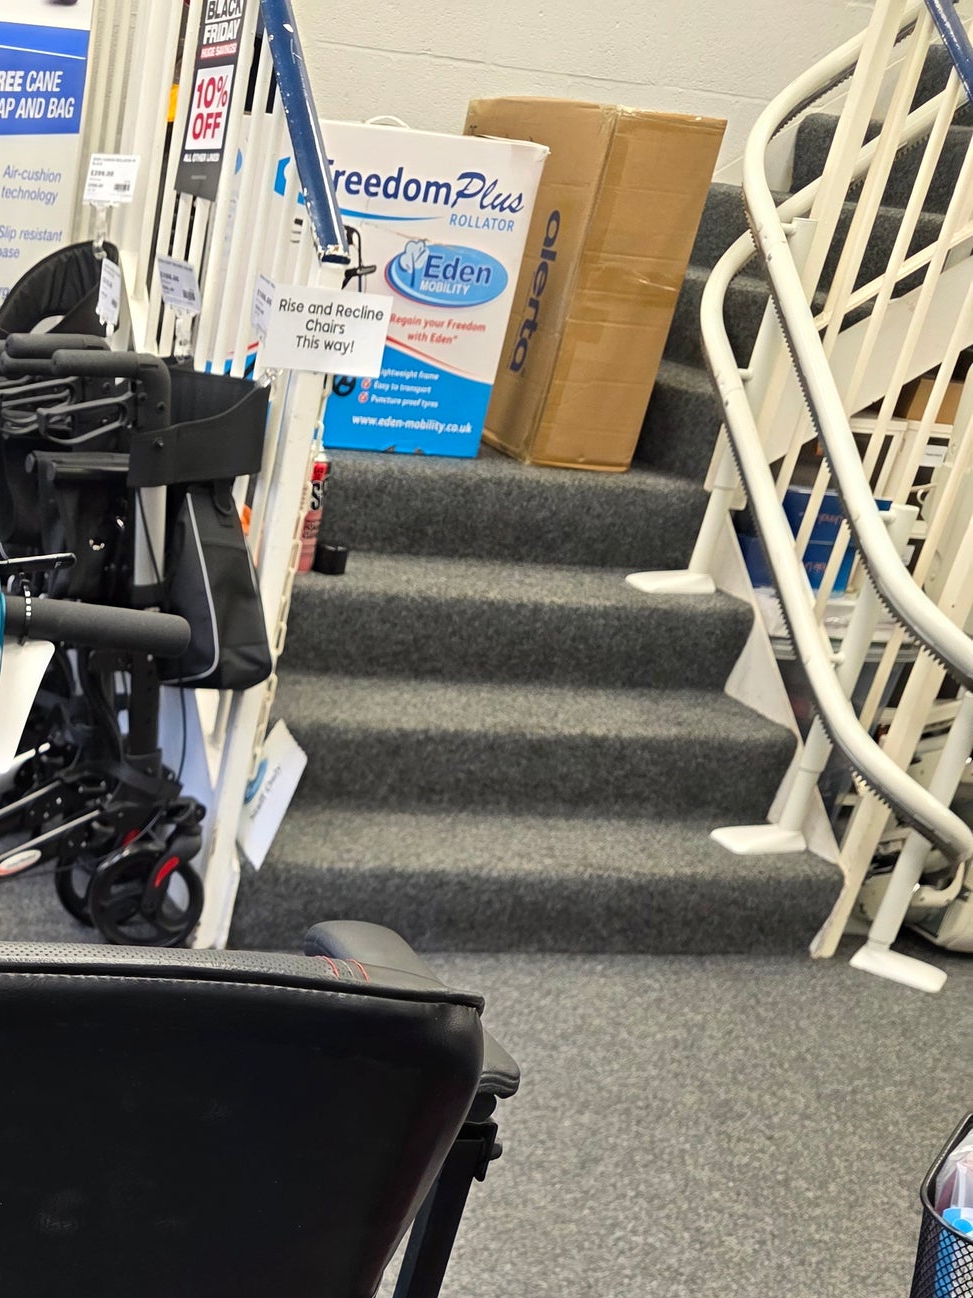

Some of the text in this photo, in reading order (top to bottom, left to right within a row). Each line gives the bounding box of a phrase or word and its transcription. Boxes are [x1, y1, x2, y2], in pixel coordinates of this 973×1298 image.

[208, 0, 242, 20] BLACK
[203, 19, 241, 45] FRIDAY
[25, 70, 64, 92] CANE
[197, 75, 228, 109] 10%
[15, 97, 46, 119] AND
[47, 97, 75, 119] BAG
[192, 112, 223, 140] OFF
[3, 164, 62, 183] Air-cushion
[1, 186, 59, 206] technology
[327, 159, 524, 214] reedomPlus
[449, 213, 515, 232] ROLLATOR
[18, 227, 63, 242] resistant
[423, 255, 492, 285] Eden
[419, 280, 471, 295] MOBILITY
[509, 209, 562, 374] alerta
[279, 297, 304, 313] Rise
[307, 302, 333, 316] and
[335, 304, 384, 321] Recline
[305, 318, 345, 335] Chairs
[390, 313, 486, 332] Regain your Freedom
[296, 335, 355, 356] This way!
[407, 332, 428, 342] with
[381, 367, 418, 380] ightweight
[390, 382, 399, 391] to
[352, 414, 473, 435] www.eden-mobility.co.uk
